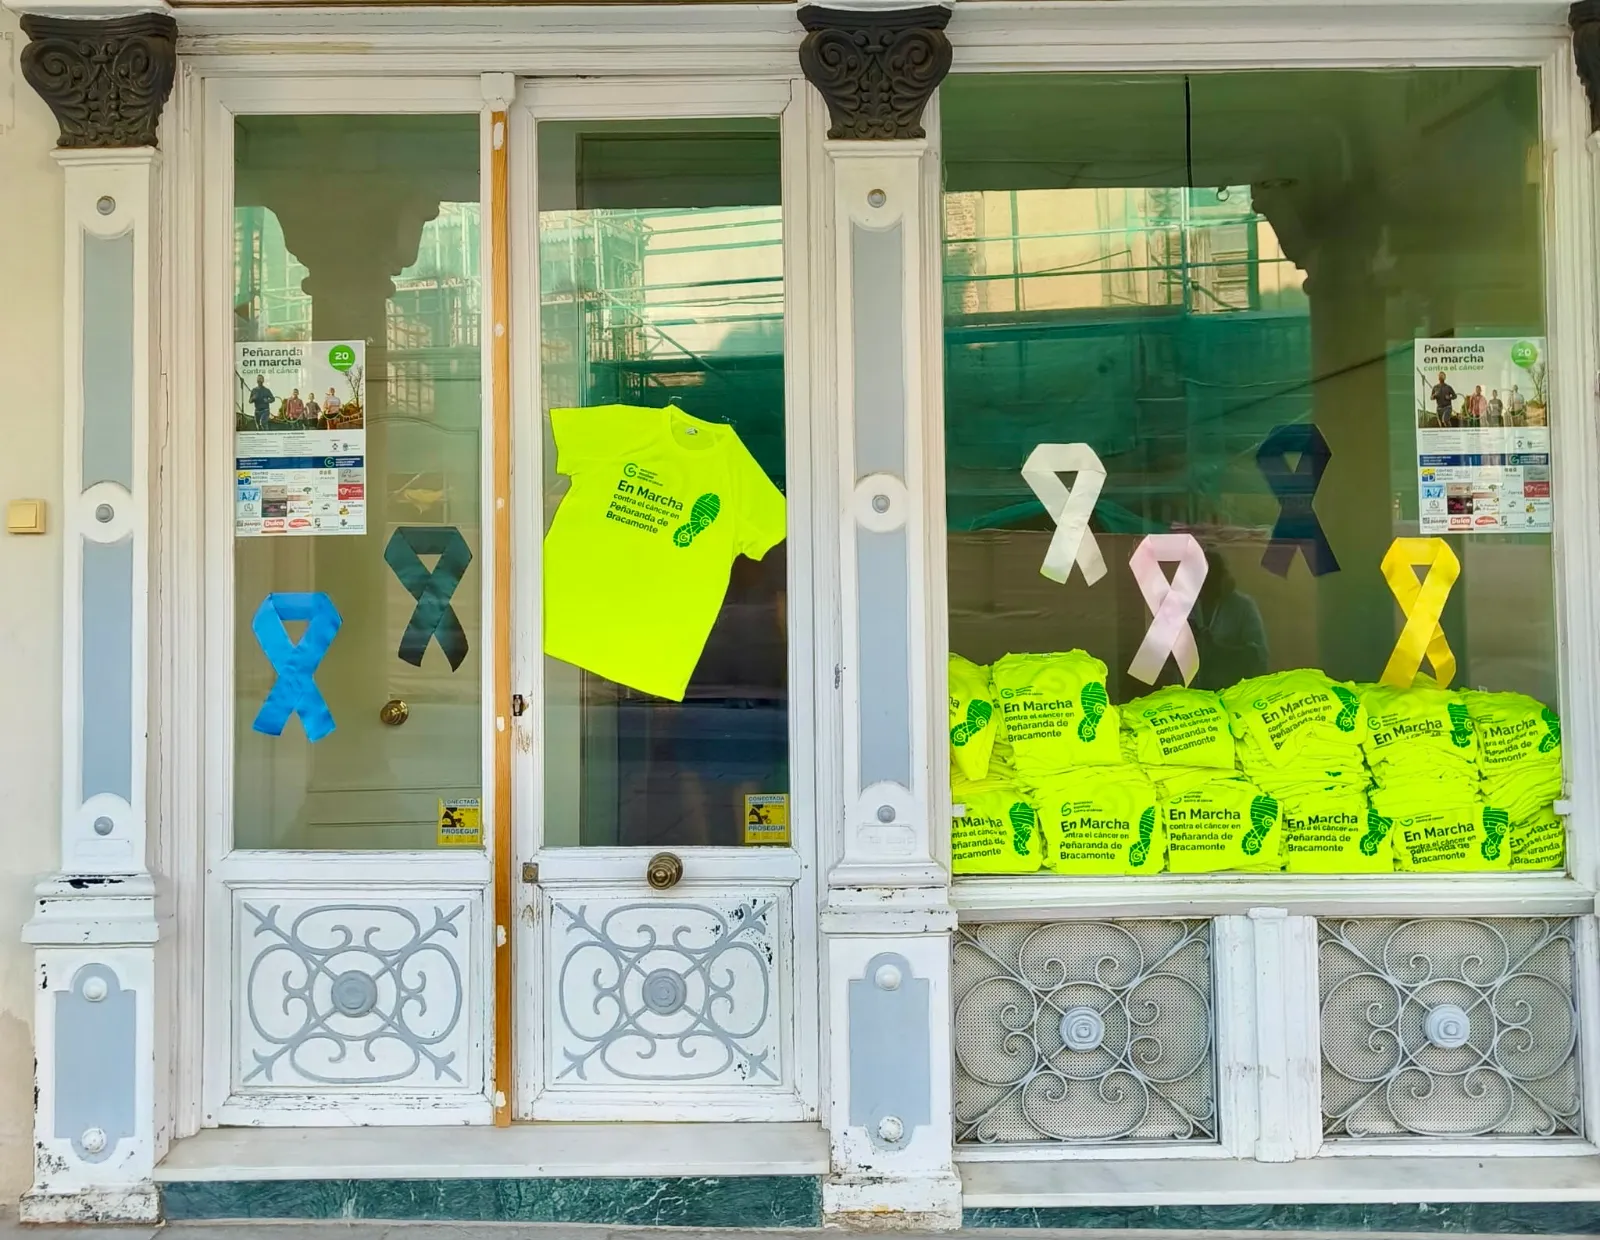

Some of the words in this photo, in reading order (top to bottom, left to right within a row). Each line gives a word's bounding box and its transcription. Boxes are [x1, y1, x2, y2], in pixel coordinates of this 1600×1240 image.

[242, 348, 303, 357] Peñaranda
[1424, 344, 1485, 353] Peñaranda
[336, 352, 349, 360] 20
[1441, 355, 1484, 363] marcha
[242, 359, 258, 367] en
[260, 358, 301, 366] marcha
[617, 480, 634, 493] En
[637, 486, 684, 511] Marcha
[614, 493, 637, 505] contra
[637, 501, 645, 509] el
[646, 503, 670, 516] cáncer
[670, 512, 680, 520] en
[610, 501, 655, 523] Peñaranda
[657, 517, 668, 527] de
[606, 510, 658, 534] Bracamonte
[1004, 703, 1020, 713] En
[1024, 700, 1073, 711] Marcha
[1262, 712, 1280, 724] En
[1280, 694, 1329, 716] Marcha
[1005, 714, 1028, 722] contra
[1150, 717, 1168, 727] En
[1170, 707, 1217, 722] Marcha
[1289, 713, 1296, 721] el
[1297, 706, 1321, 718] cáncer
[1007, 720, 1054, 732] Peñaranda
[1056, 719, 1068, 727] de
[1156, 724, 1179, 735] contra
[1188, 717, 1211, 726] cáncer
[1490, 719, 1537, 737] Marcha
[1008, 730, 1061, 742] Bracamonte
[1160, 728, 1206, 745] Peñaranda
[1208, 724, 1218, 732] de
[1373, 733, 1392, 745] En
[1393, 719, 1443, 737] Marcha
[1163, 736, 1216, 755] Bracamonte
[1521, 741, 1532, 749] de
[1169, 809, 1186, 820] En
[1190, 808, 1240, 820] Marcha
[1061, 821, 1076, 832] En
[1080, 818, 1129, 830] Marcha
[1287, 819, 1304, 829] En
[1308, 813, 1358, 825] Marcha
[953, 830, 967, 838] ntra
[1323, 824, 1347, 832] cáncer
[1404, 831, 1421, 843] En
[1424, 822, 1474, 838] Marcha
[1170, 832, 1218, 840] Peñaranda
[1221, 832, 1233, 840] de
[1287, 834, 1337, 842] Peñaranda
[1339, 834, 1351, 842] de
[953, 839, 994, 849] eñaranda
[1060, 841, 1108, 849] Peñaranda
[1111, 842, 1122, 850] de
[1170, 843, 1225, 851] Bracamonte
[1288, 844, 1343, 852] Bracamonte
[1440, 838, 1466, 848] cáncer
[1510, 837, 1524, 848] En
[953, 848, 1001, 860] racamonte
[1060, 852, 1115, 860] Bracamonte
[1412, 851, 1466, 865] Bracamonte
